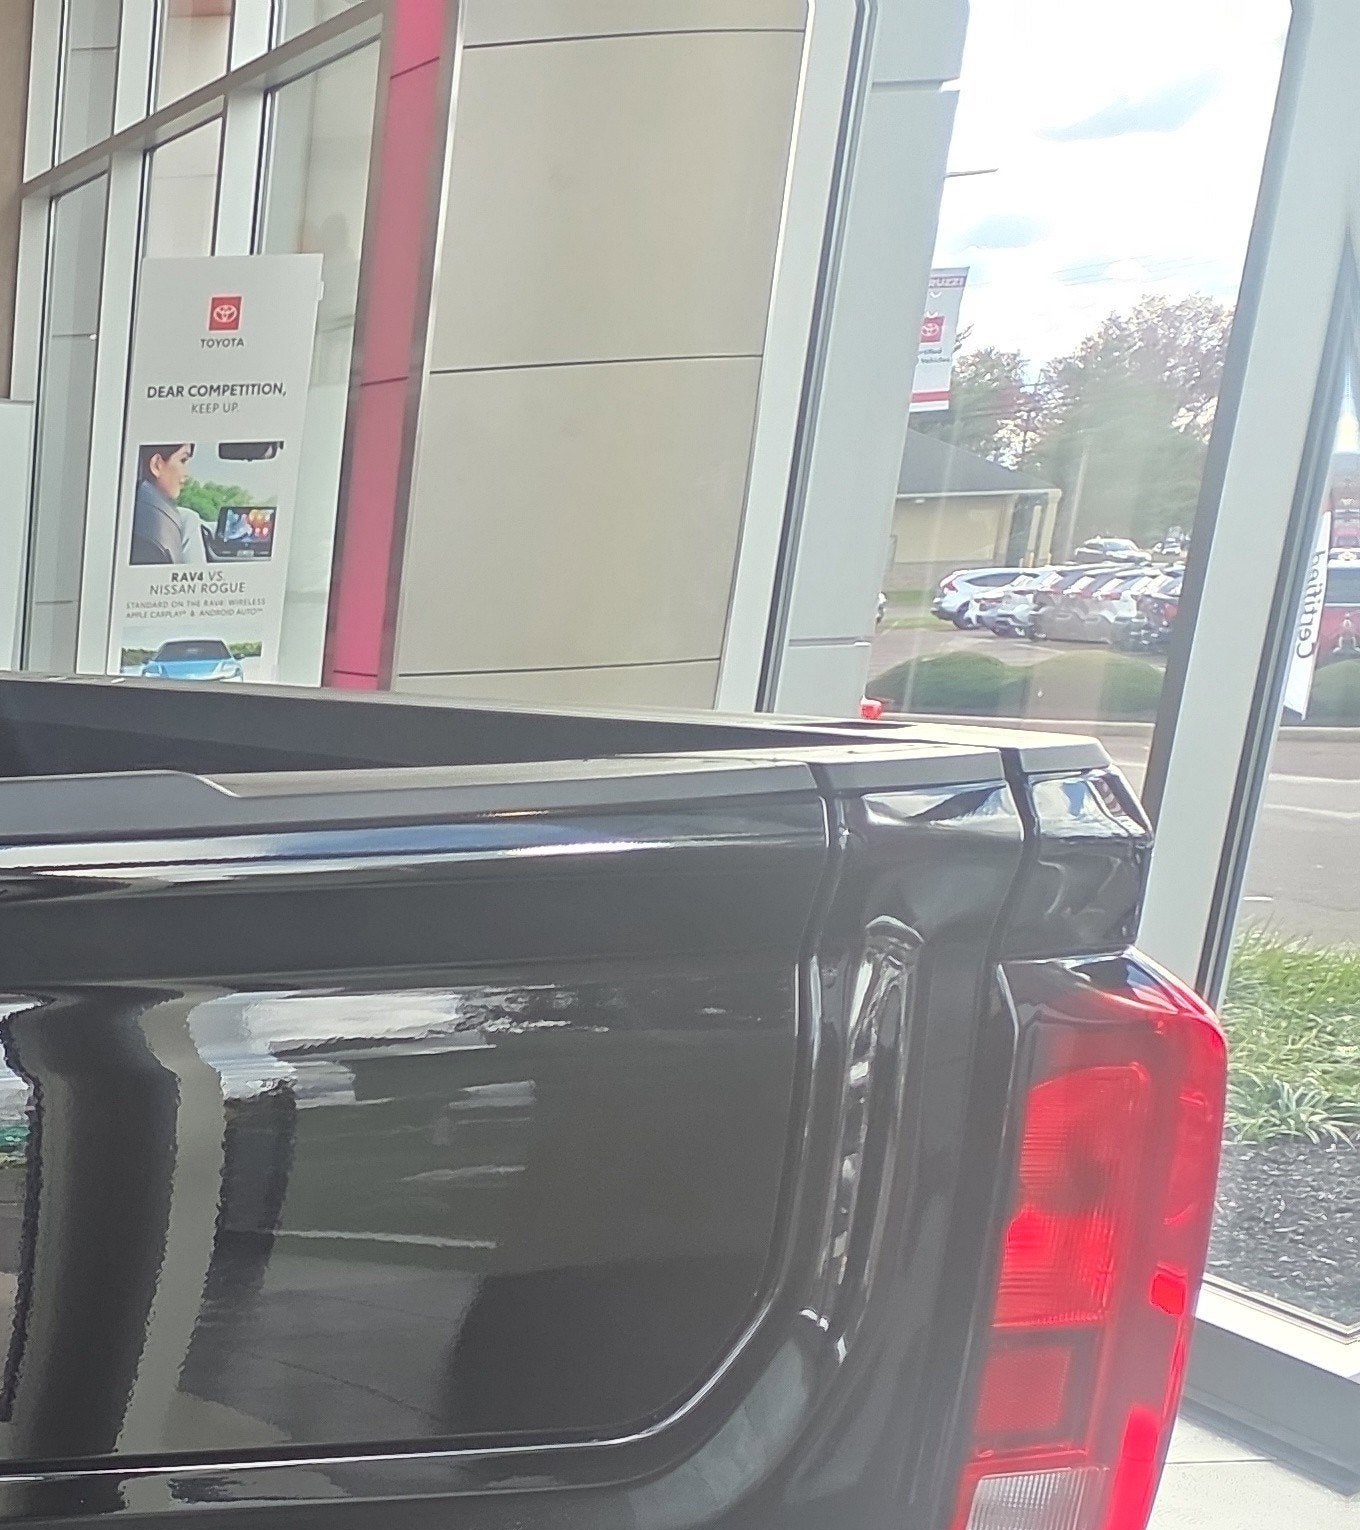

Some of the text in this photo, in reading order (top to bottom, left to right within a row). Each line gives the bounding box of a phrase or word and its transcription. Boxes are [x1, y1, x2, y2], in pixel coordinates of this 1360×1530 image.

[200, 338, 245, 349] TOYOTA
[147, 382, 287, 399] DEAR COMPETITION,
[191, 402, 220, 414] KEEP
[171, 570, 224, 583] RAV4 VS
[149, 581, 246, 596] NISSAN ROGUE
